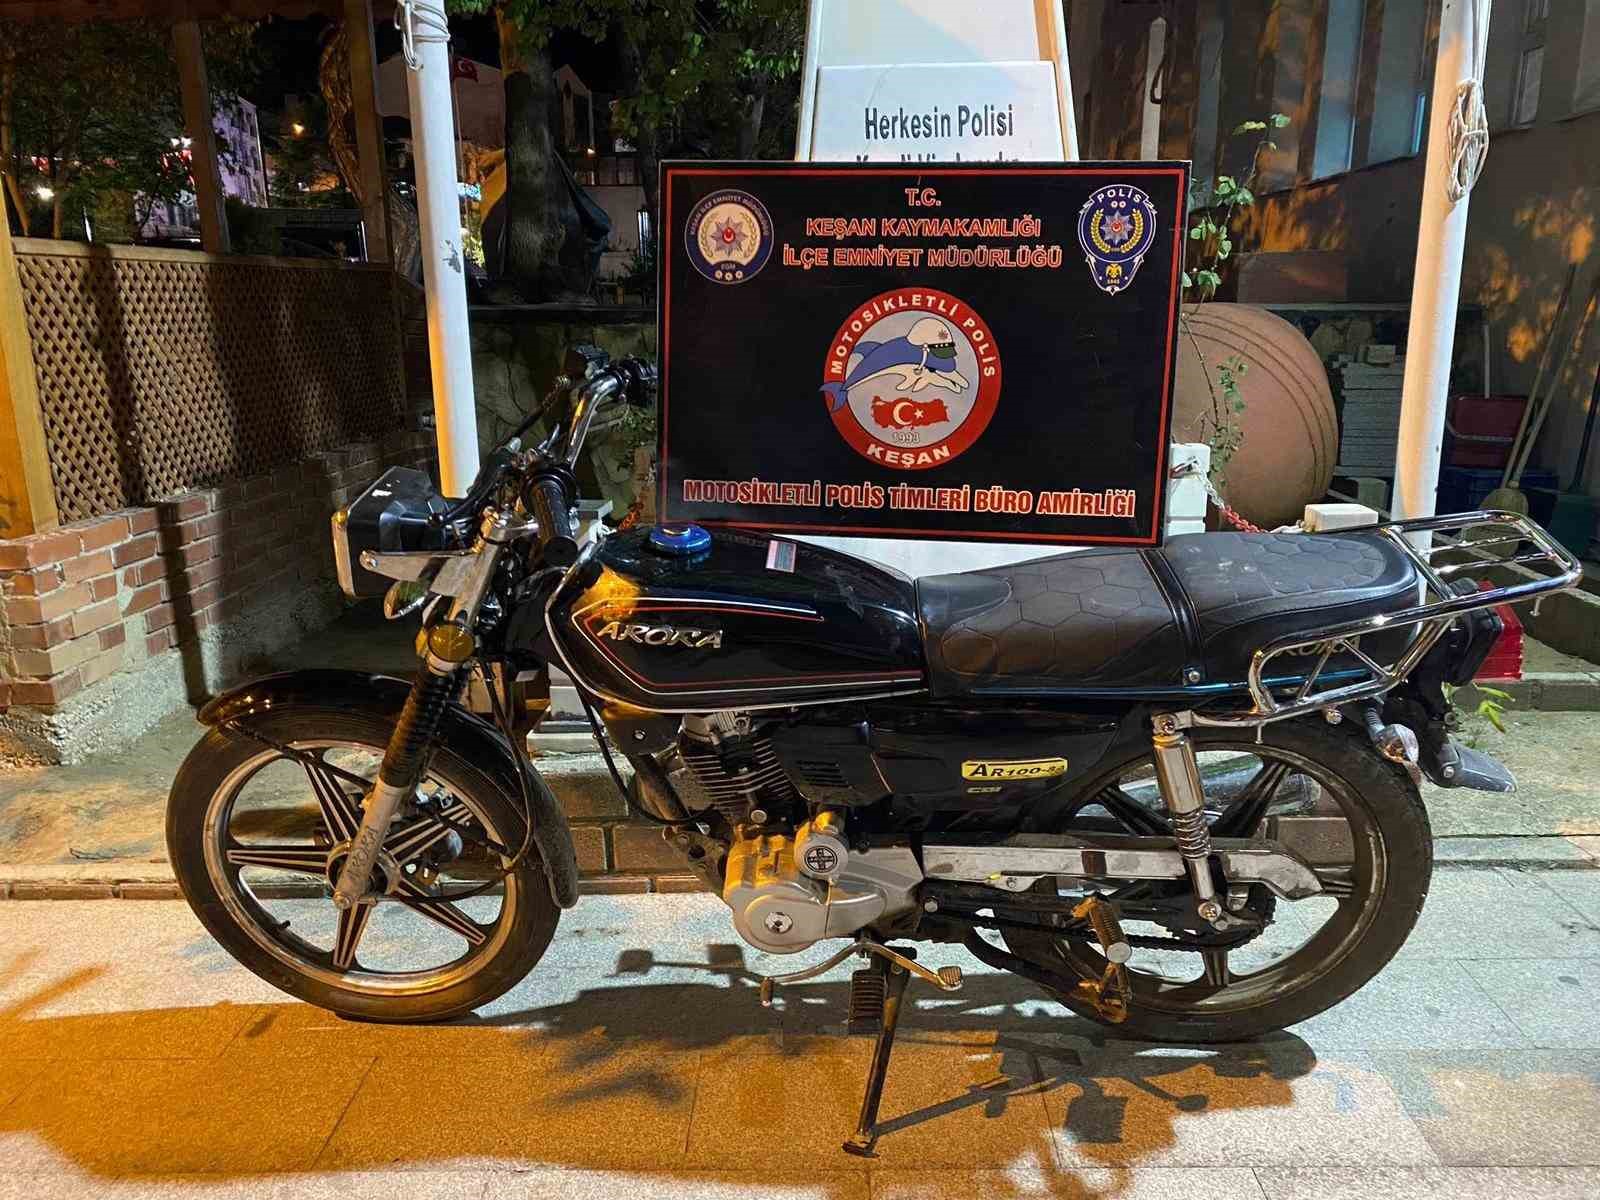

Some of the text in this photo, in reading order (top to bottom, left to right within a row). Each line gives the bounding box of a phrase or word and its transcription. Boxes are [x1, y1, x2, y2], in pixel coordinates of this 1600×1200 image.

[864, 103, 1013, 140] Herkesin Polisi
[904, 187, 942, 207] T.C.
[1096, 188, 1142, 203] POLİS
[805, 214, 1042, 241] KEŞAN KAYMAKAMLIĞI
[782, 243, 1063, 269] İLÇE EMNİYET MÜDÜRLÜĞÜ
[830, 294, 997, 377] MOTOSİKLETLİ POLİS
[866, 443, 950, 468] KEŞAN
[683, 477, 1137, 518] MOTOSİKLETLİ POLİS TİMLERİ BÜRO AMİRLİĞİ
